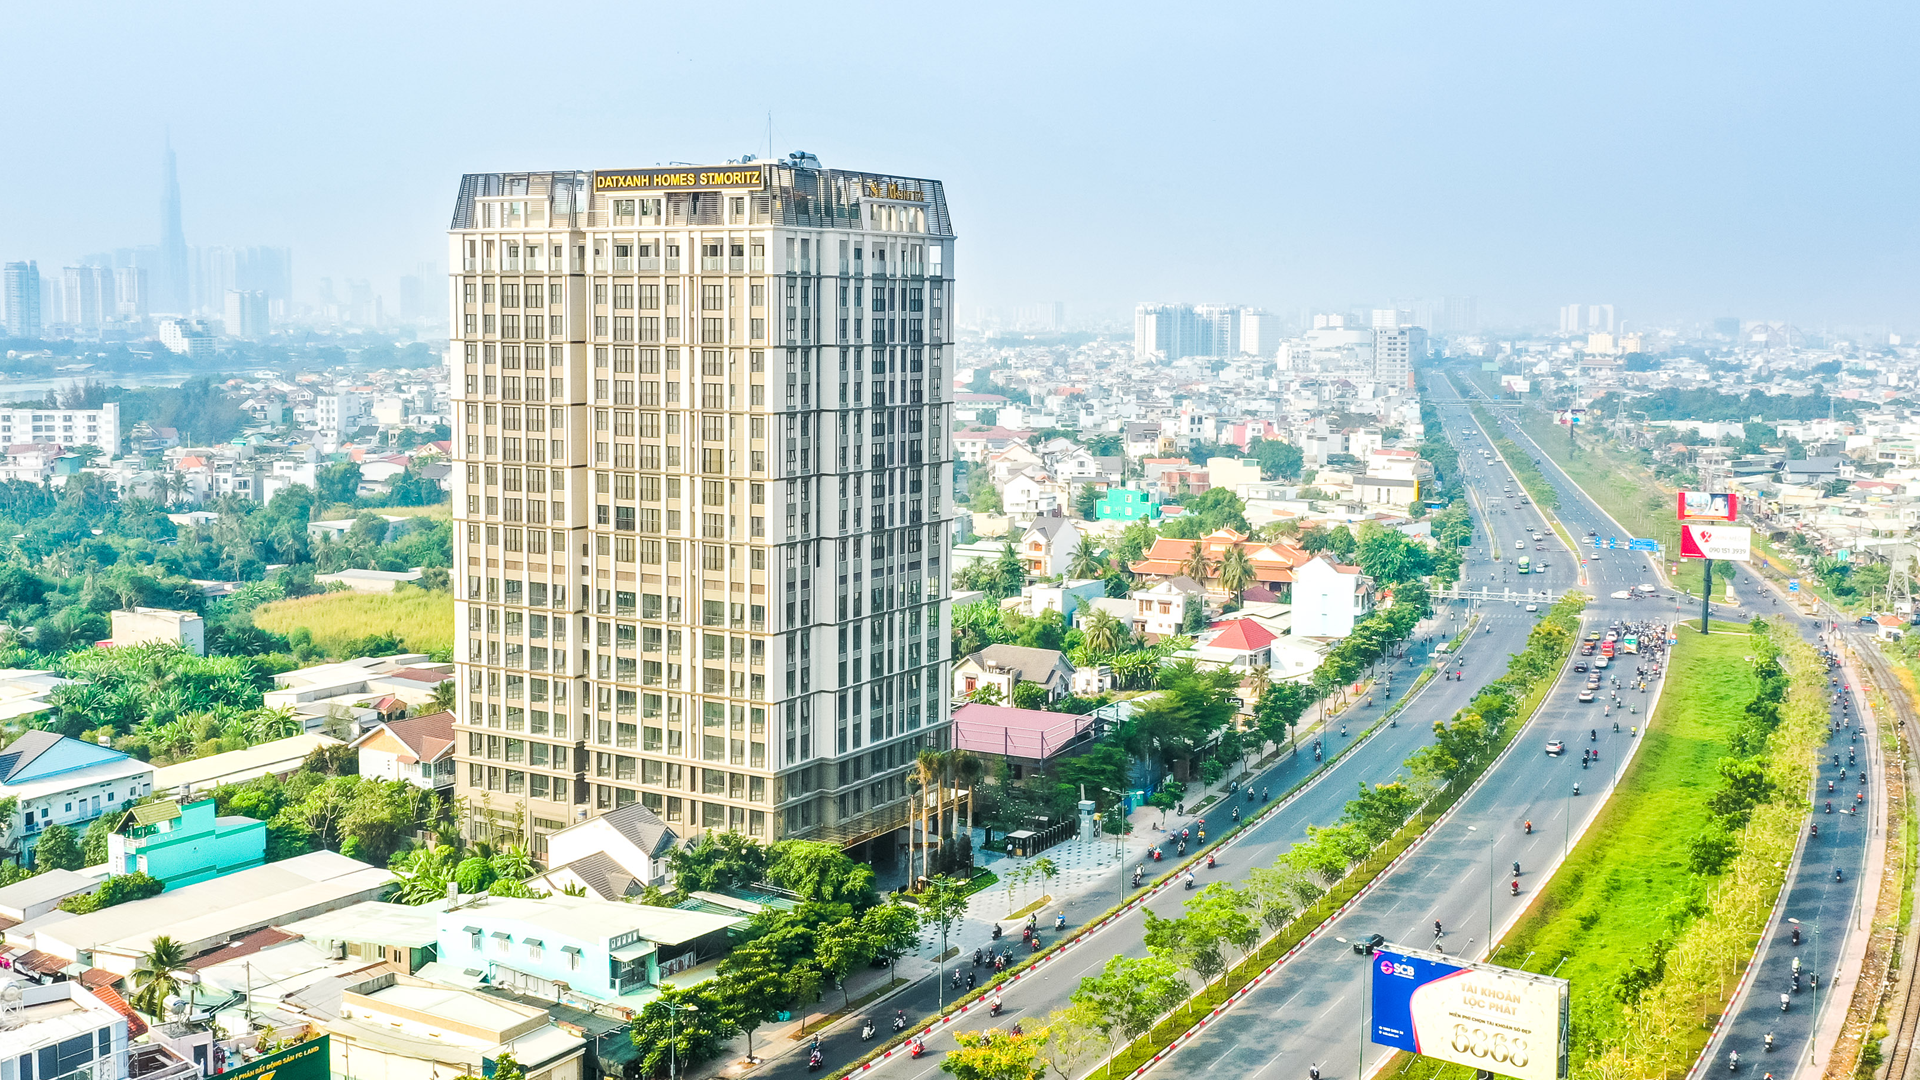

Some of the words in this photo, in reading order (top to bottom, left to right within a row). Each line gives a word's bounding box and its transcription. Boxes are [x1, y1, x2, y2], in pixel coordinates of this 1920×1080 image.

[597, 174, 649, 188] DATXANH
[653, 173, 696, 187] HOMES
[1393, 962, 1415, 977] SCB
[1461, 982, 1477, 994] TÀI
[1489, 1002, 1518, 1016] PHÁT
[304, 1046, 320, 1056] LAND
[1451, 1023, 1529, 1068] 6868
